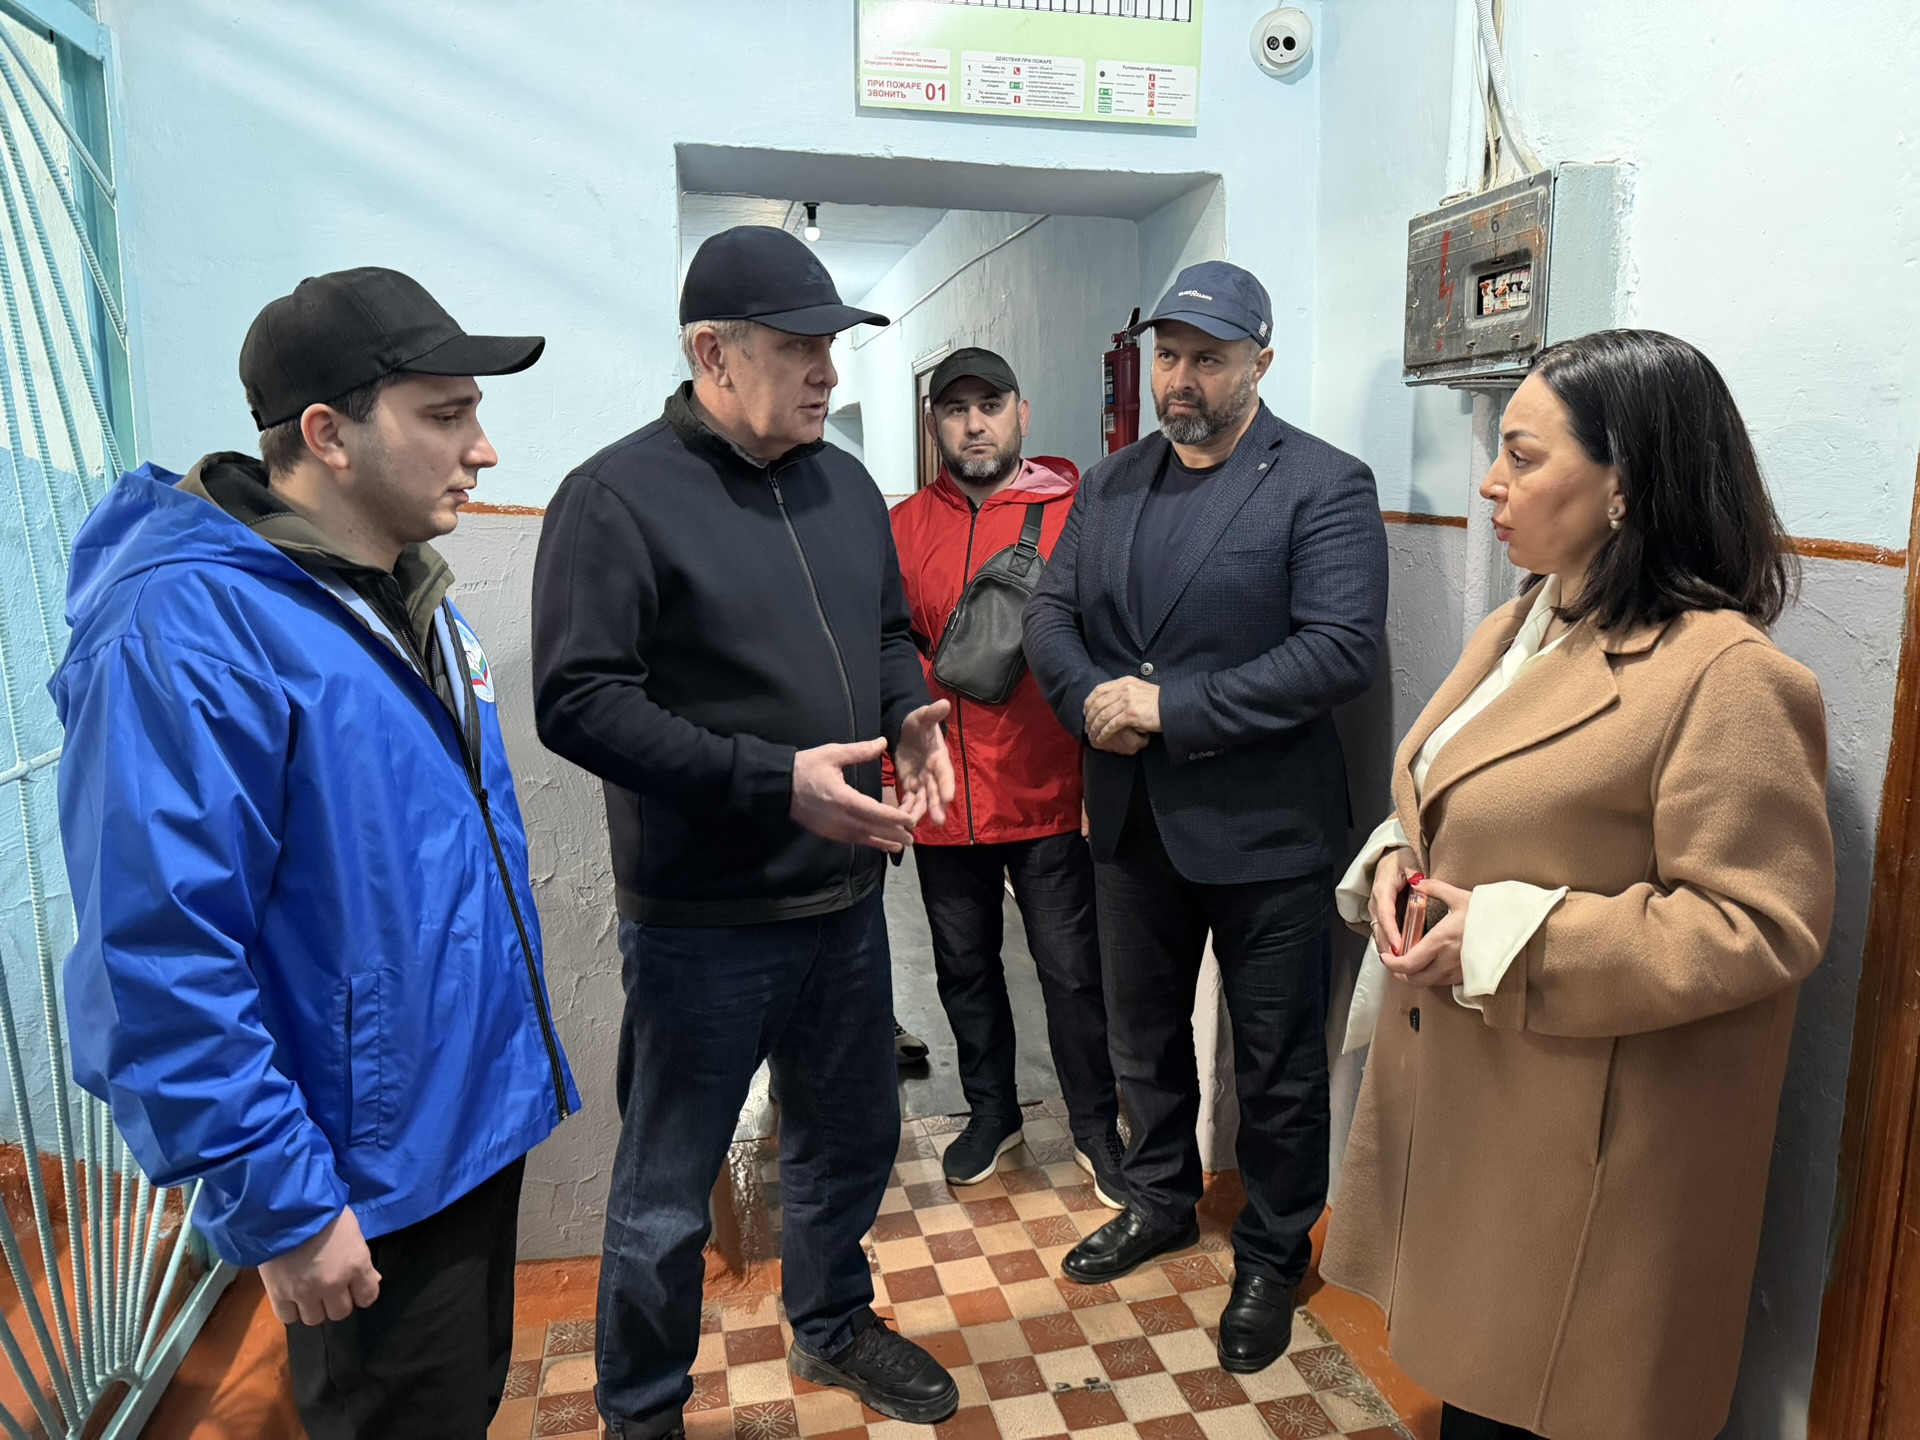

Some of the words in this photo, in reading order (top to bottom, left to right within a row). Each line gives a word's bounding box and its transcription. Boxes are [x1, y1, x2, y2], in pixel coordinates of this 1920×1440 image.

[886, 80, 922, 90] ПОЖАРЕ
[867, 90, 906, 99] ЗВОНИТЬ
[925, 83, 946, 101] 01
